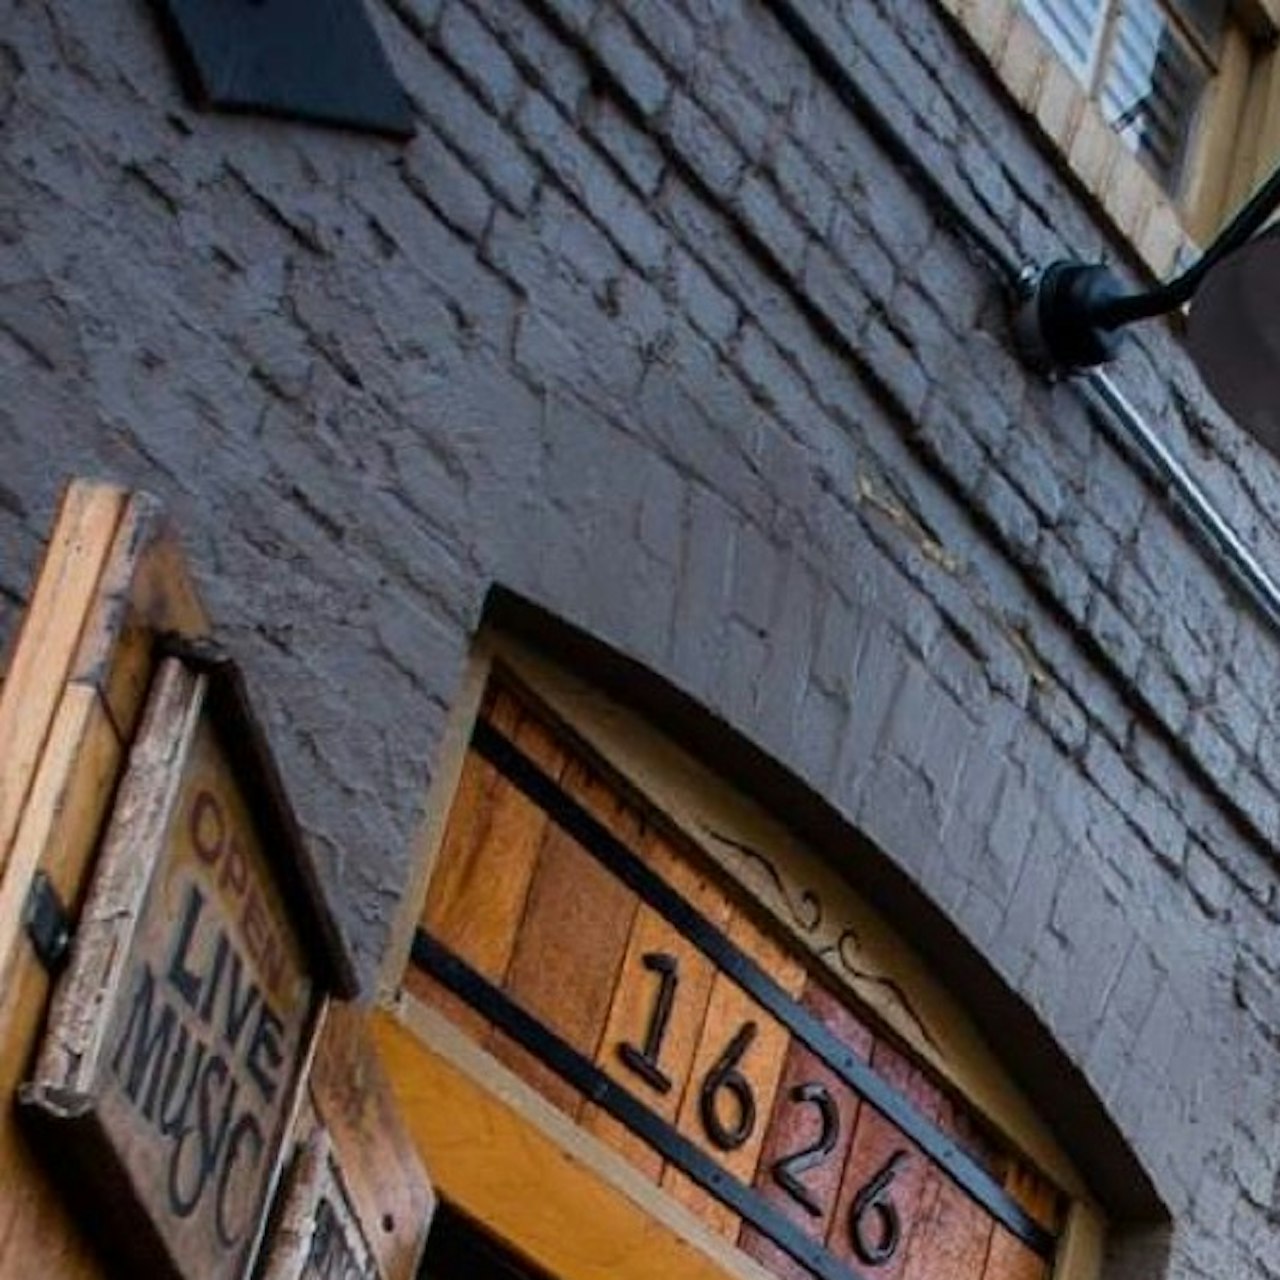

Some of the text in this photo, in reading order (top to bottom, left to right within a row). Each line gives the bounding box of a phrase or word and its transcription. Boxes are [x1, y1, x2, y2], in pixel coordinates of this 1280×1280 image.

[167, 882, 283, 1097] LIVE
[188, 788, 292, 1005] OPEN
[110, 960, 264, 1250] MUSIC
[616, 952, 900, 1267] 1626
